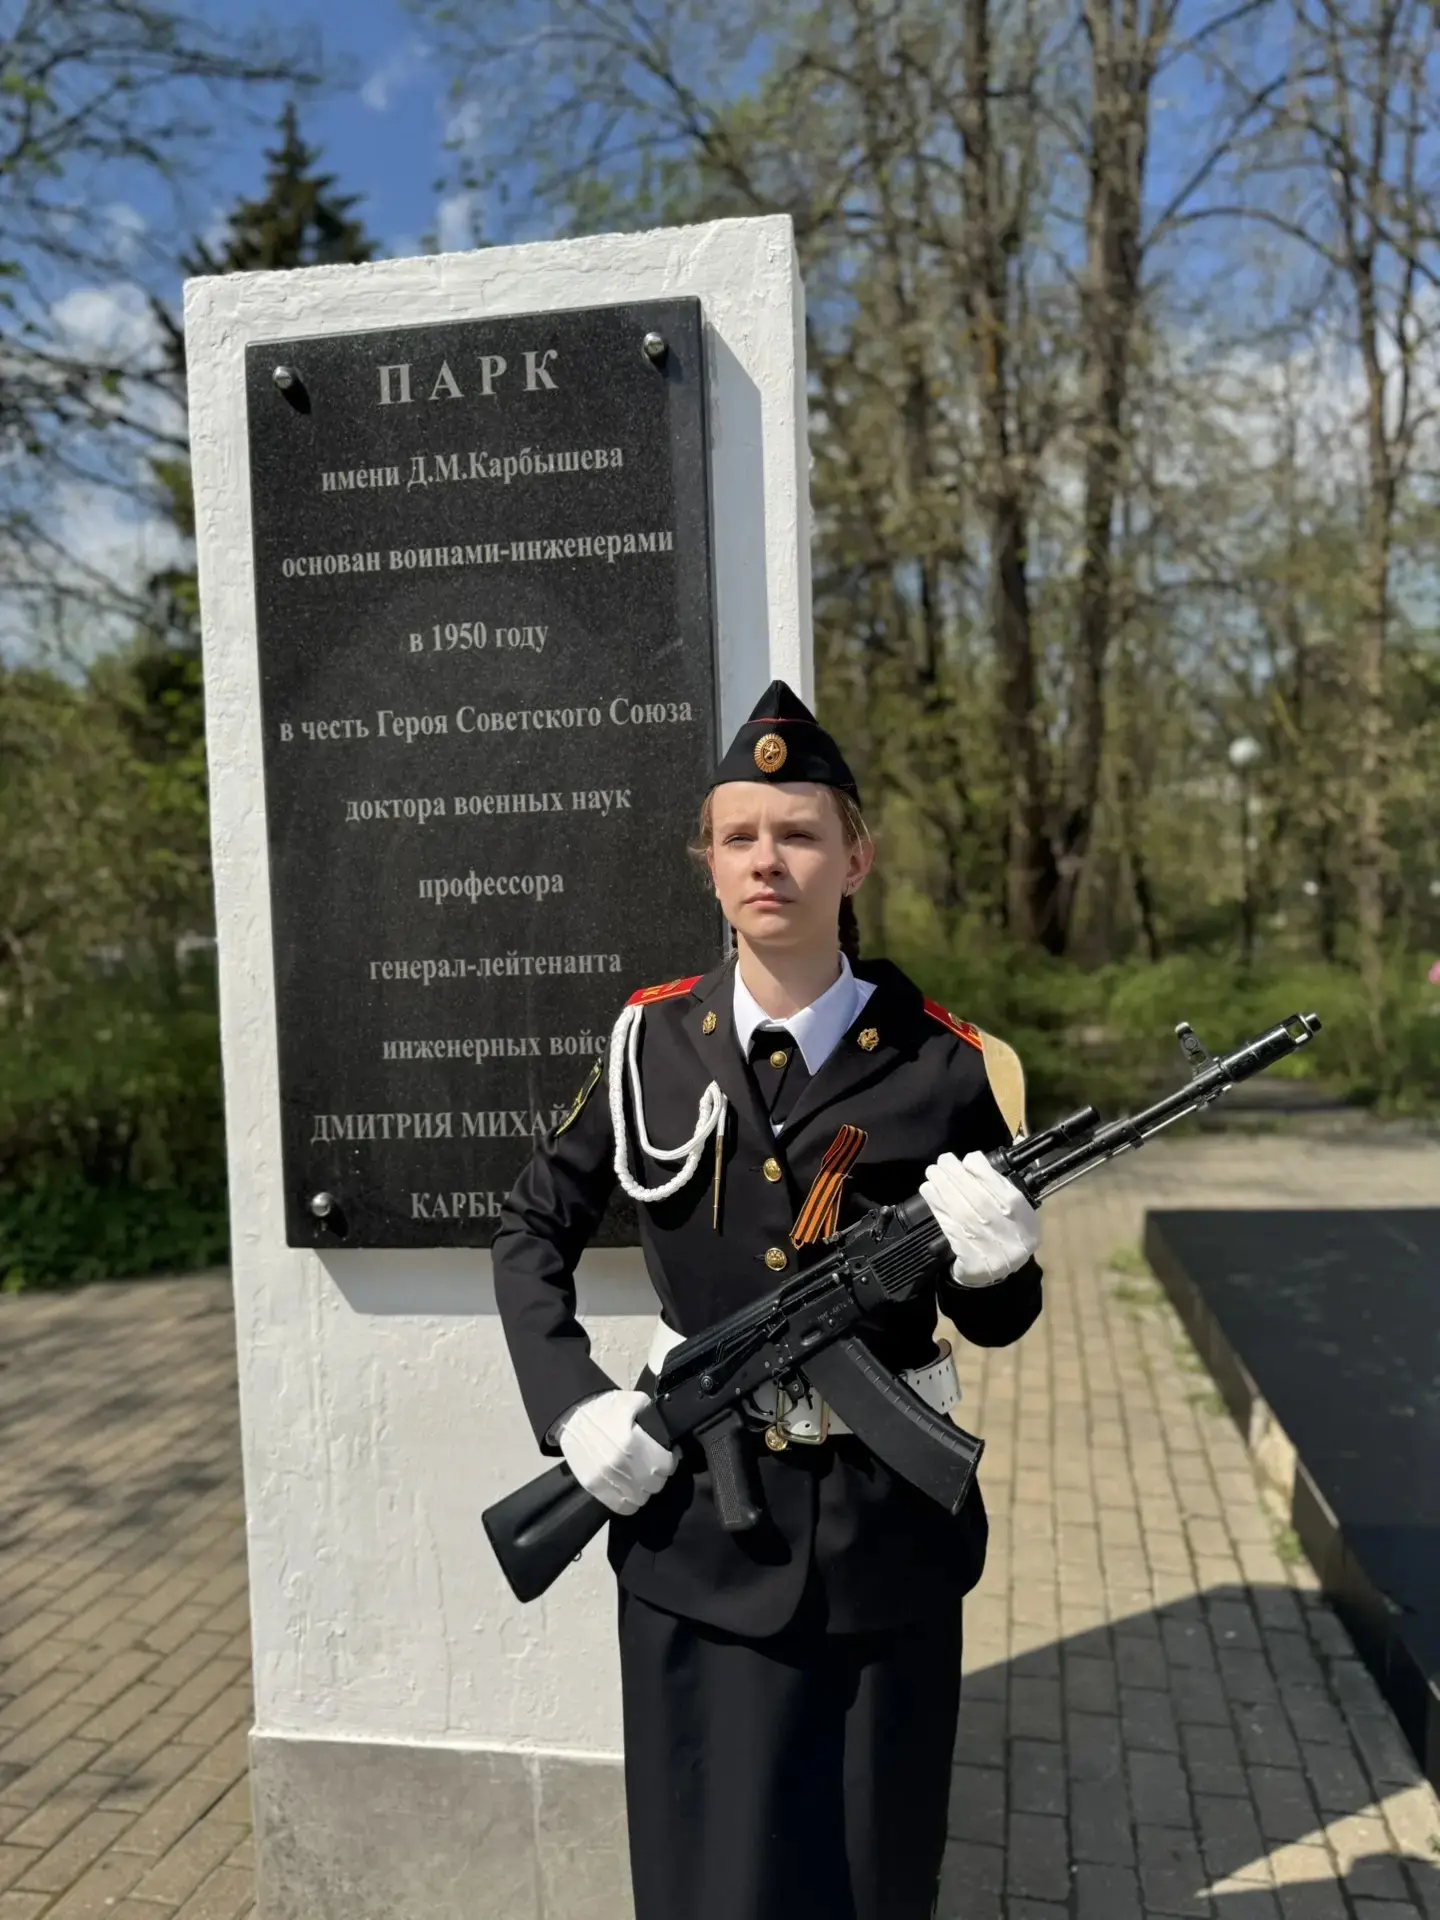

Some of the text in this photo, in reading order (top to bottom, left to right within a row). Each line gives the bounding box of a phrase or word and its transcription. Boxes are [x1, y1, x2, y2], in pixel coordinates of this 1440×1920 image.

[376, 349, 560, 406] ПАРК
[321, 446, 624, 493] имени Д.М.Карбышева
[281, 530, 675, 578] основан воинами-инженерами
[409, 621, 550, 654] в 1950 году
[279, 697, 693, 744] в честь Героя Советского Союза
[344, 787, 633, 826] доктора военных наук
[417, 869, 565, 905] профессора
[368, 949, 623, 986] генерал-лейтенанта
[381, 1028, 611, 1066] инженерных войс
[310, 1111, 454, 1145] ДМИТРИЯ
